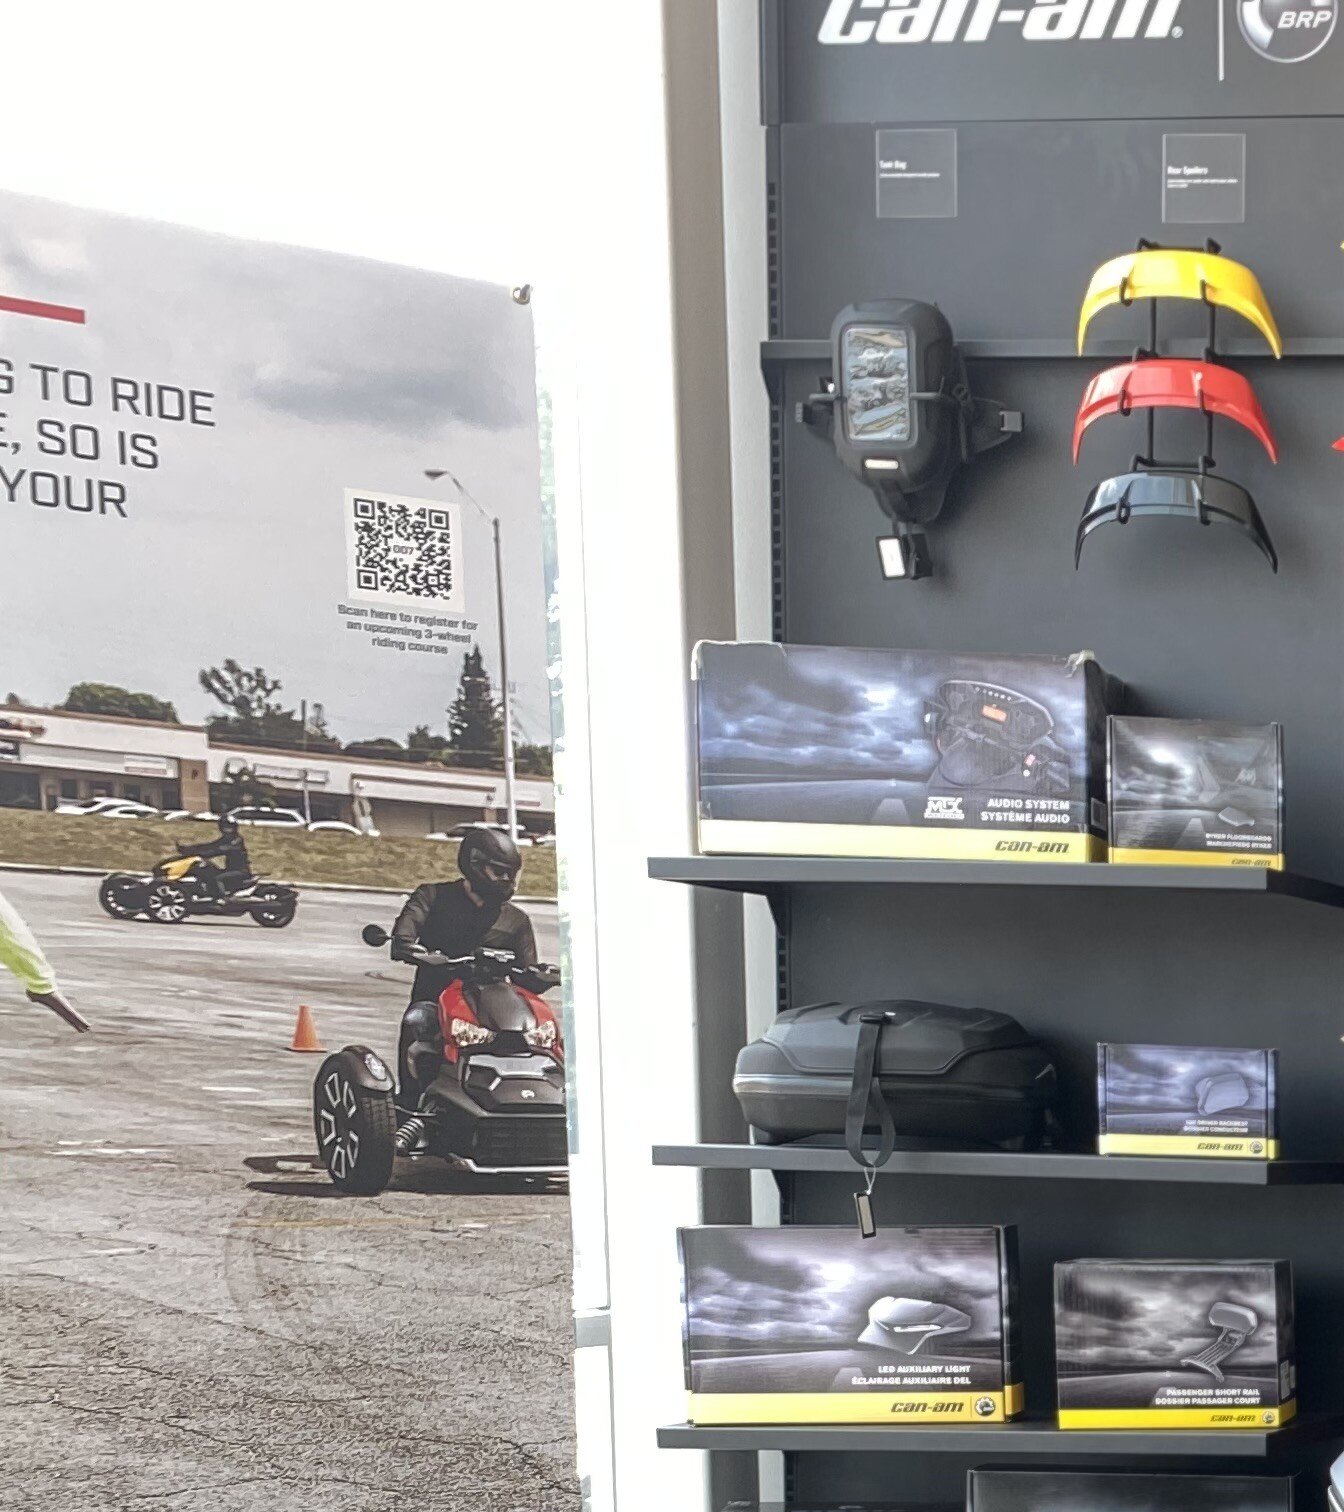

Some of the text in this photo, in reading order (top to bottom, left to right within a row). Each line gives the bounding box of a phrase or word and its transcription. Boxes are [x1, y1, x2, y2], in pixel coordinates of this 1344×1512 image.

[817, 0, 1178, 44] can-am
[1276, 9, 1333, 30] BRP
[29, 362, 93, 407] TO
[110, 376, 216, 427] RIDE
[37, 418, 99, 460] SO
[118, 431, 159, 470] IS
[0, 466, 128, 518] YOUR
[337, 604, 478, 630] Scan here to register for
[346, 621, 472, 643] an upcoming 3-wheel
[371, 637, 448, 655] riding course
[987, 798, 1070, 811] AUDIO SYSTEM
[980, 810, 1070, 824] SYSTÈME AUDIO
[995, 840, 1070, 853] can-am
[1197, 1143, 1244, 1151] can-am
[878, 1365, 971, 1374] LED AUXILIARY LIGHT
[902, 1377, 953, 1385] AUXILIAIRE
[954, 1377, 971, 1385] DEL
[1167, 1388, 1213, 1396] PASSENGER
[1215, 1388, 1241, 1396] SHORT
[891, 1402, 964, 1413] can-am
[1155, 1397, 1261, 1405] DOSSIER PASSAGER COURT
